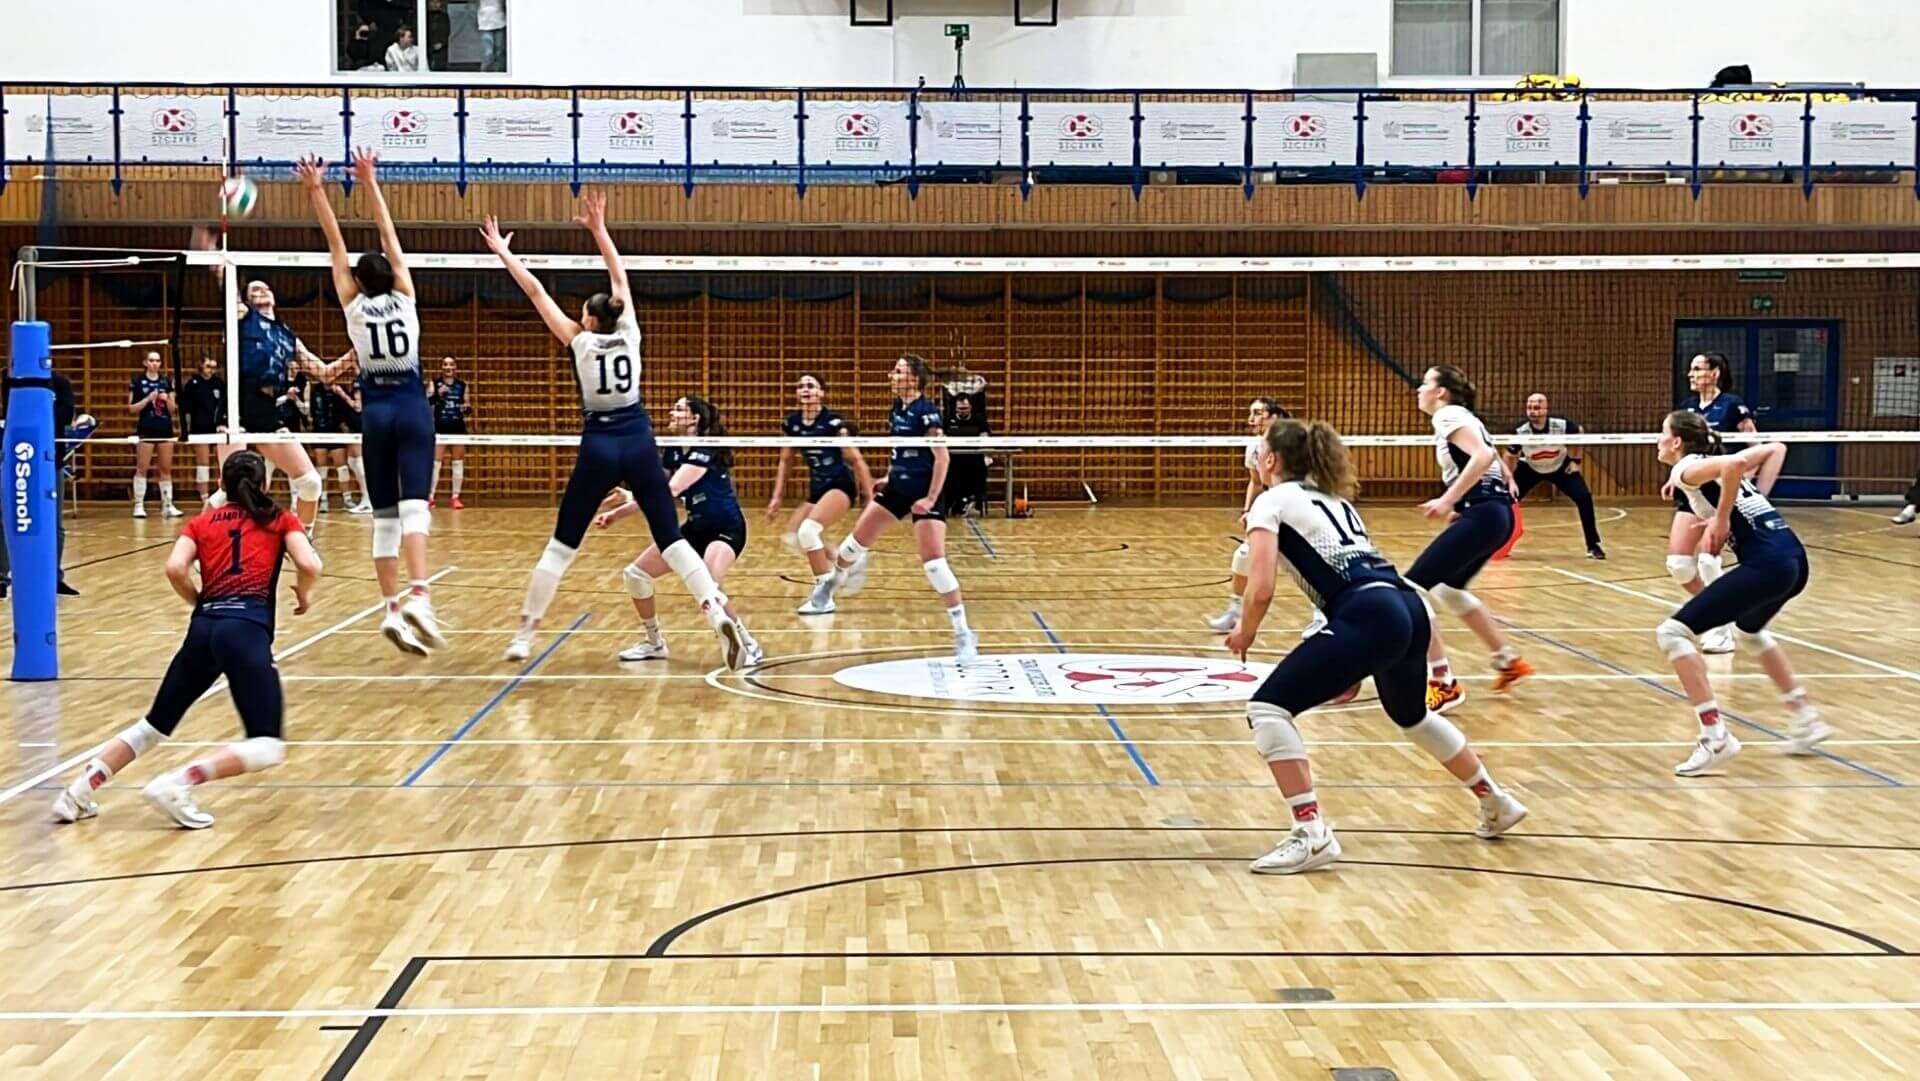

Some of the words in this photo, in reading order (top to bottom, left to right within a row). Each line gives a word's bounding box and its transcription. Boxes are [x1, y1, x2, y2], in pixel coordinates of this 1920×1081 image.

[365, 318, 409, 360] 16
[595, 354, 632, 395] 19
[15, 462, 33, 533] Senoh
[1312, 499, 1369, 546] 14
[225, 528, 244, 576] 1
